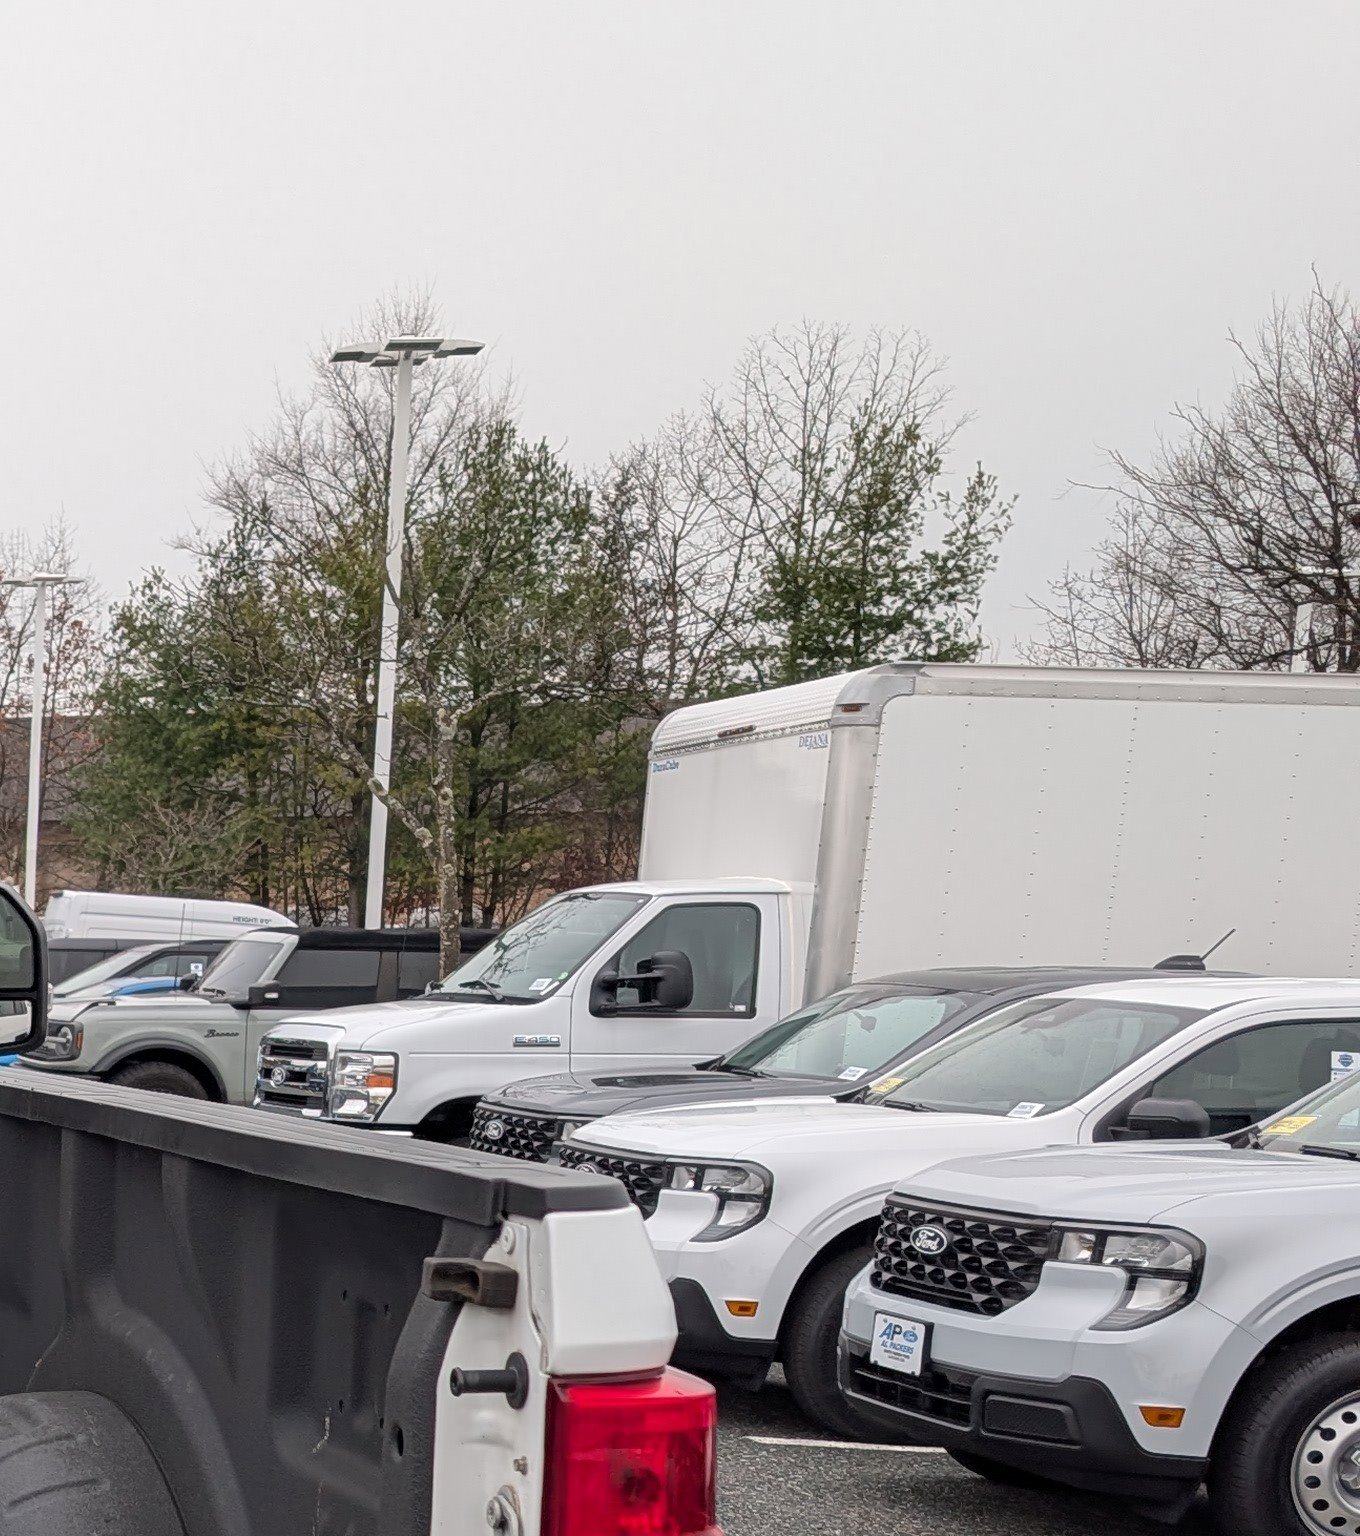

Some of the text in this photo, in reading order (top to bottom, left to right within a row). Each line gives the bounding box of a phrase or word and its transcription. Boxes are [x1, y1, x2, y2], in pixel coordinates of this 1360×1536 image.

[204, 1029, 239, 1038] Bronco
[915, 1229, 940, 1250] Ford
[879, 1322, 903, 1341] AP
